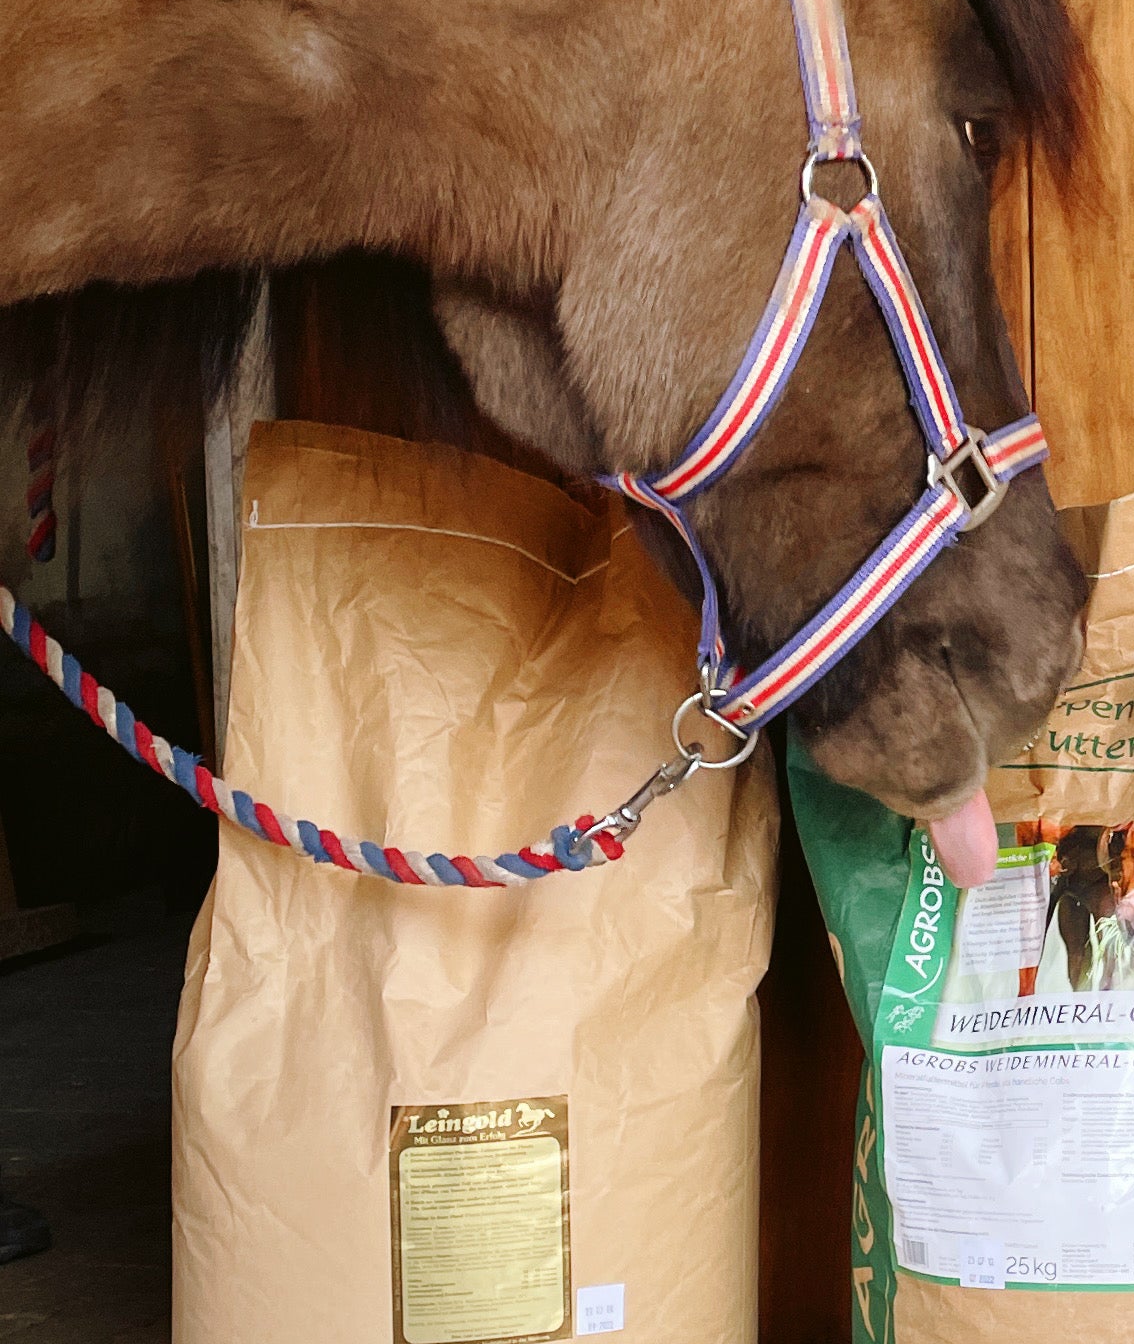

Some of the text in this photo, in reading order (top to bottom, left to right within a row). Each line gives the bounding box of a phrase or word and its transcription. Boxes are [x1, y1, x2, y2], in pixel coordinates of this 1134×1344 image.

[896, 1050, 980, 1074] AGROBS
[407, 1108, 513, 1135] Leingold
[430, 1134, 457, 1144] Glanz
